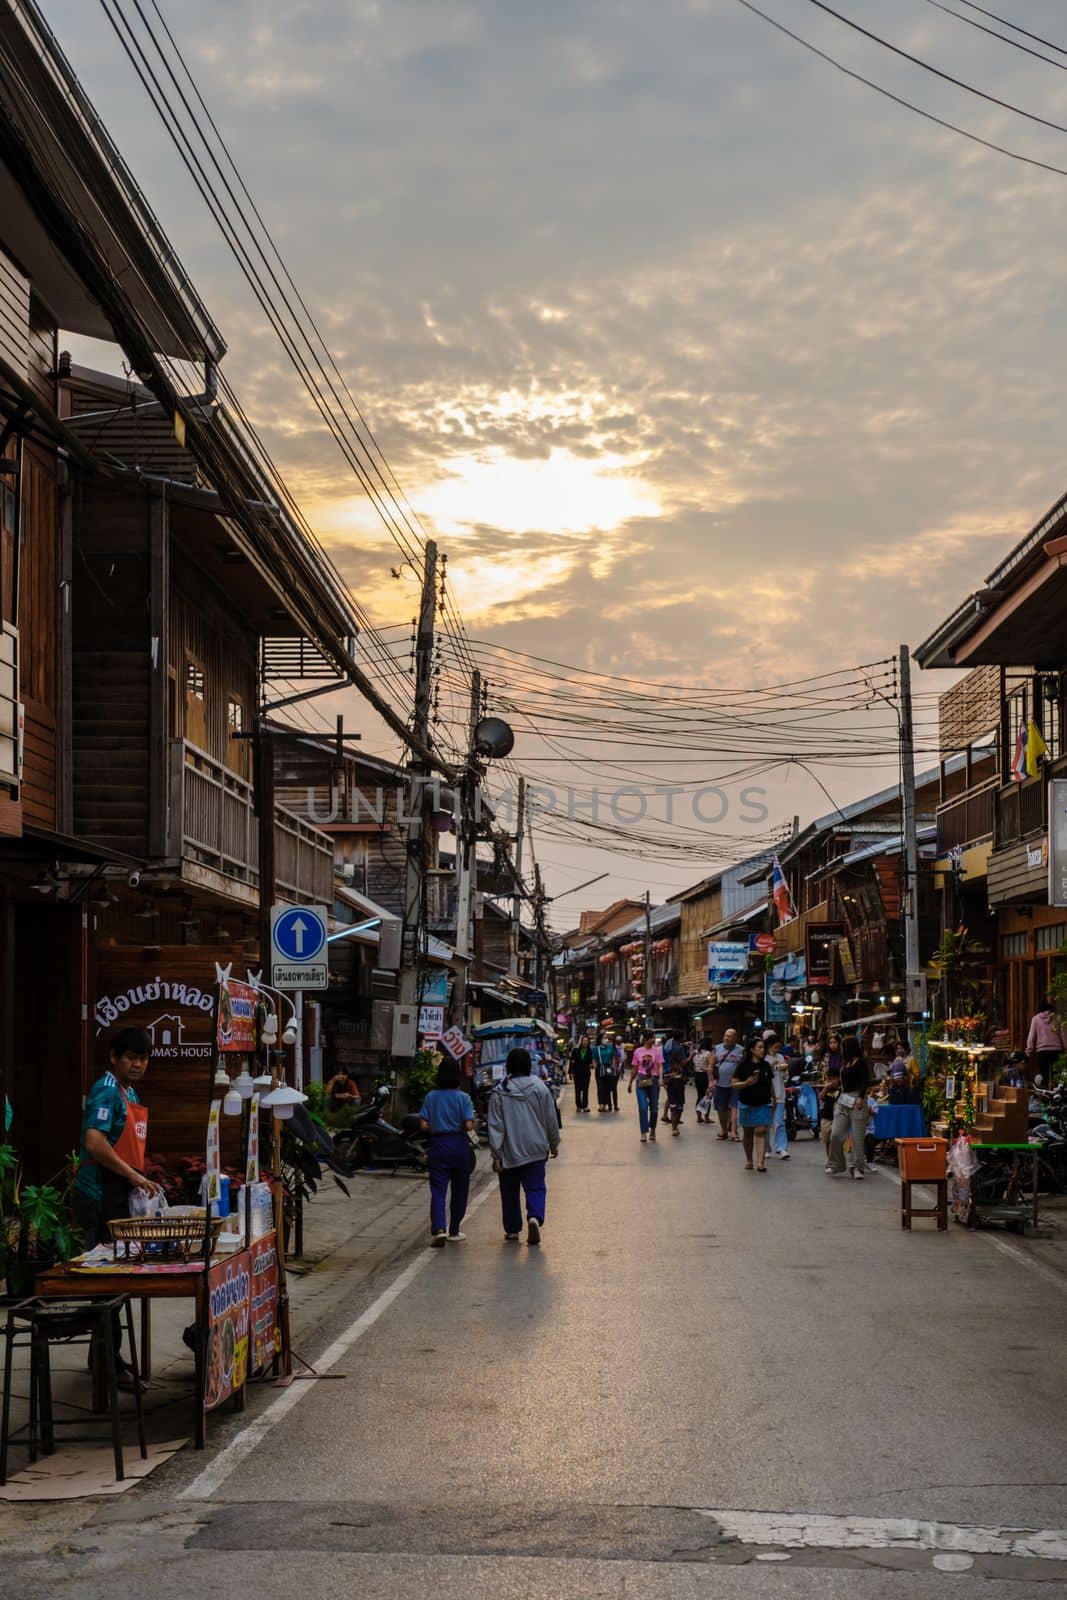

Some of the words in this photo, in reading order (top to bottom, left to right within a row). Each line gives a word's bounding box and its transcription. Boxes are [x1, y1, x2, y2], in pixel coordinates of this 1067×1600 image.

[275, 967, 325, 982] เดินรถทางเดียว
[96, 976, 214, 1028] เฮือนย่าหลอ
[181, 1047, 212, 1057] HOUS
[444, 1031, 466, 1056] ว่าง
